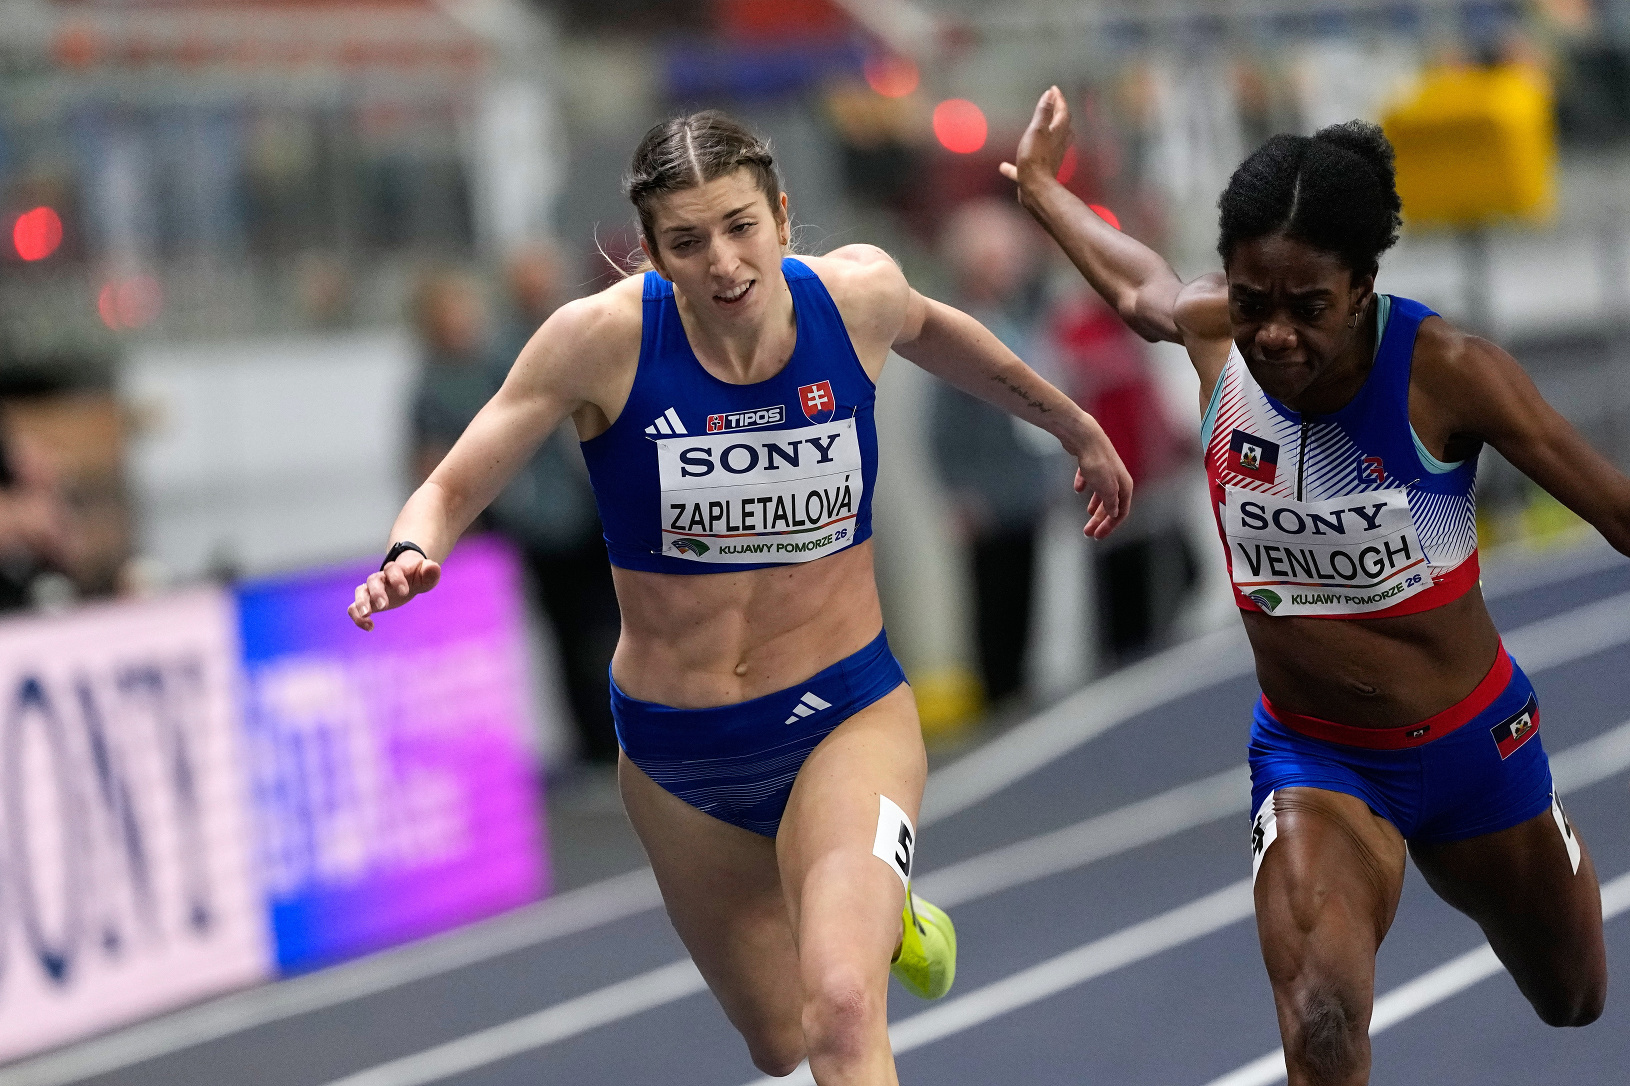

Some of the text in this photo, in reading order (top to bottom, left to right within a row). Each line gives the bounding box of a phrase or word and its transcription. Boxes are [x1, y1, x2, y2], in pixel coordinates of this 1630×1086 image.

[727, 408, 781, 428] TIPOS
[679, 433, 841, 478] SONY
[670, 474, 852, 532] ZAPLETALOVÁ
[1240, 502, 1388, 536] SONY
[719, 528, 848, 555] KUJAWY POMORZE 26
[1237, 535, 1412, 581] VENLOGH
[1291, 573, 1422, 605] KUJAWY POMORZE 26
[894, 820, 913, 877] 5
